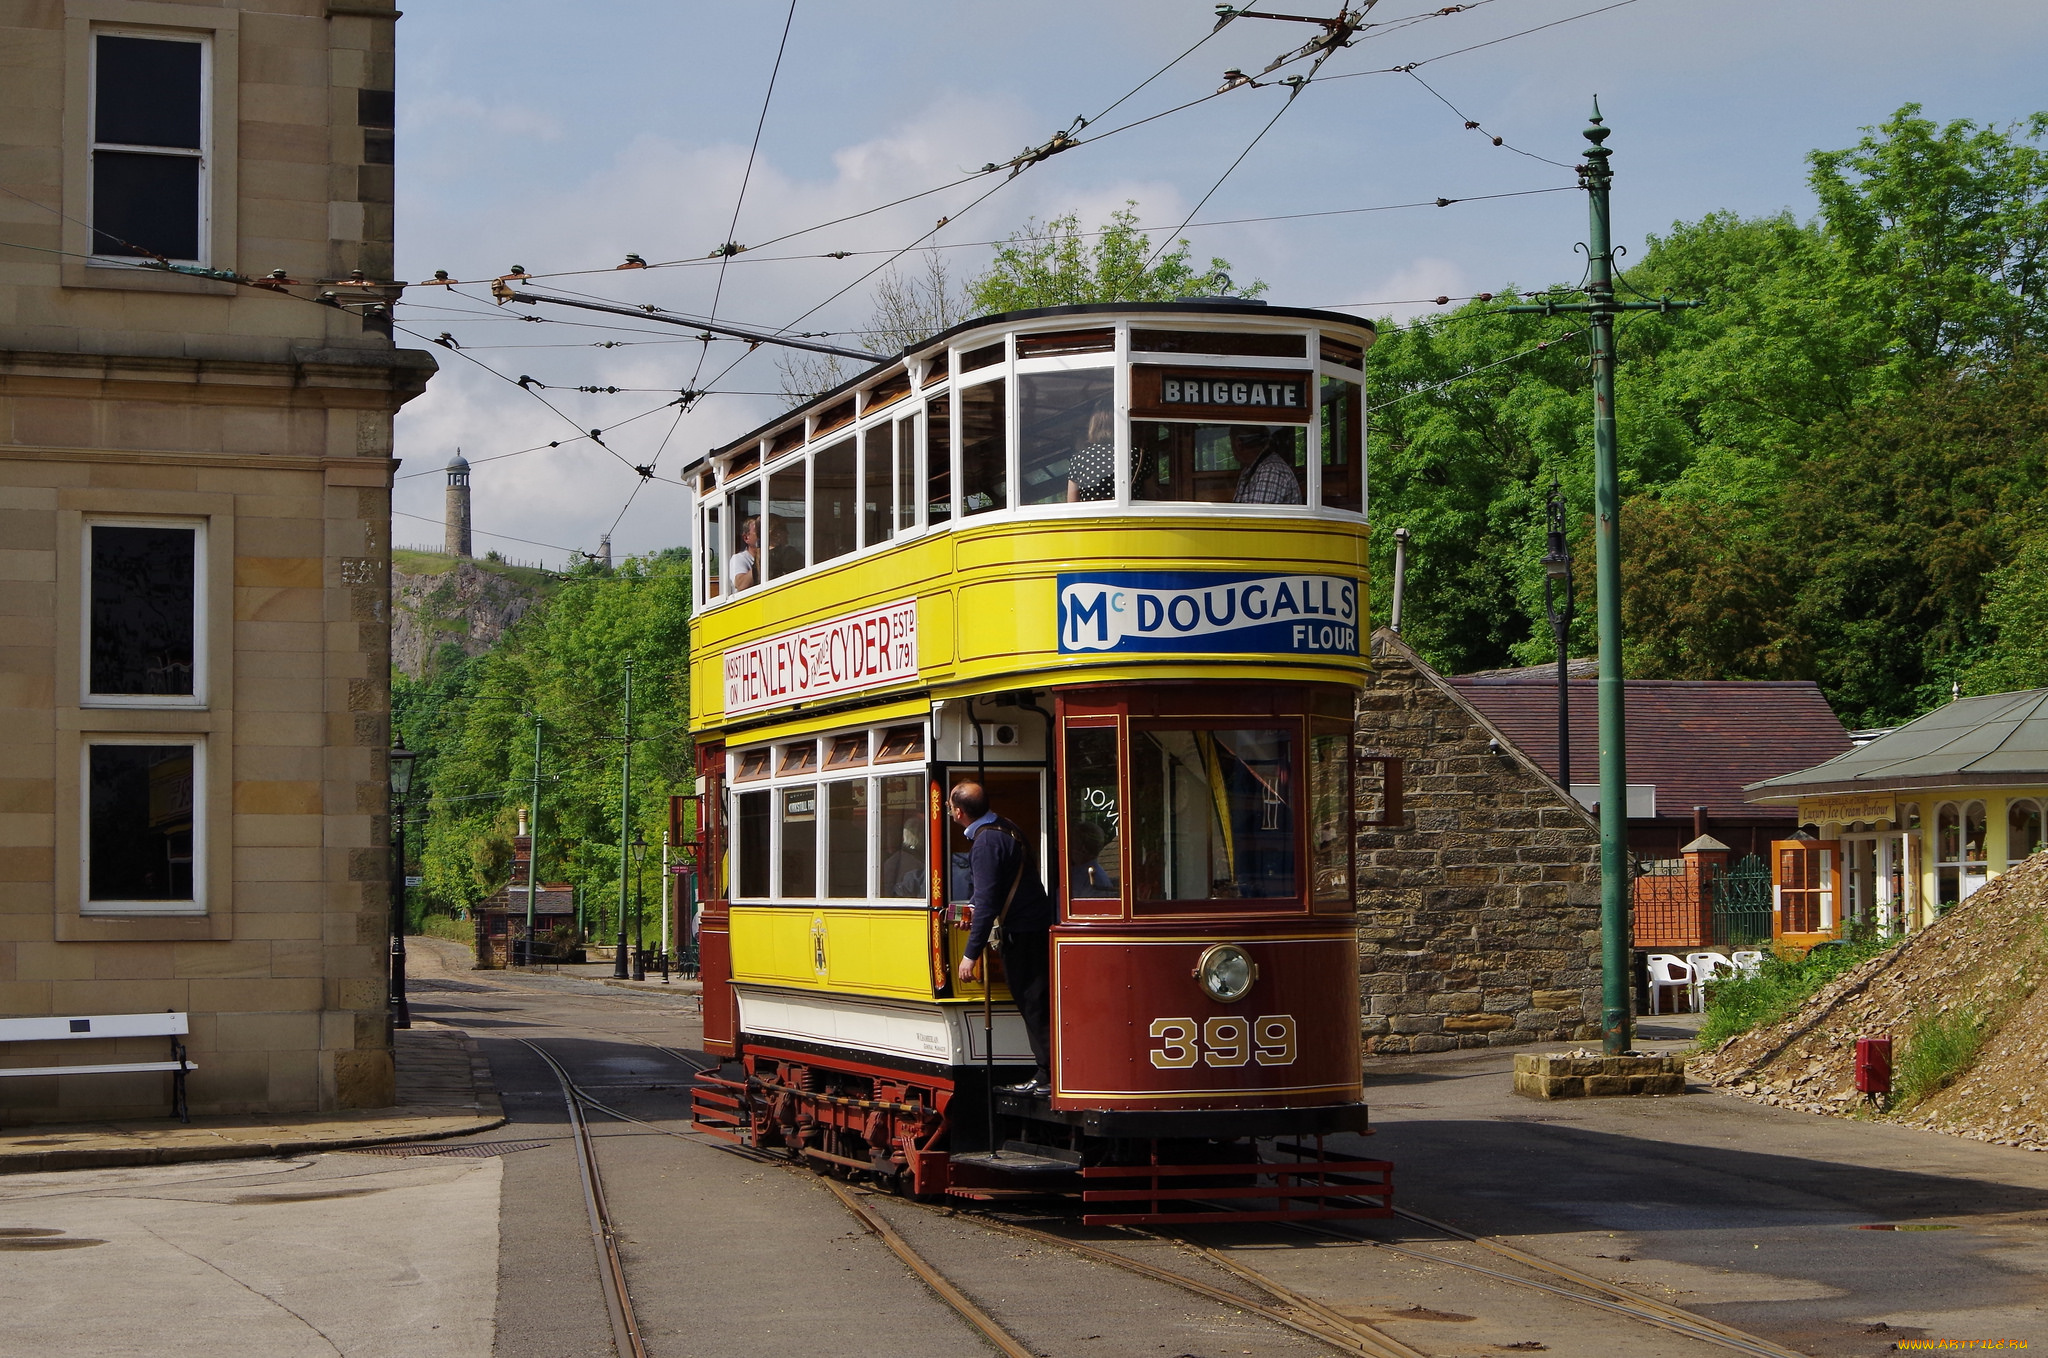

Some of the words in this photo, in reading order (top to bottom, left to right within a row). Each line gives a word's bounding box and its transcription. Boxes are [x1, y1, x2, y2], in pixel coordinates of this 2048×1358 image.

[1165, 380, 1297, 406] BRIGGATE
[811, 633, 829, 685] FAMOUS
[829, 616, 892, 683] CYDER
[1292, 625, 1355, 650] FLOUR
[726, 655, 741, 681] INSIST
[895, 641, 914, 670] 1791
[730, 684, 739, 706] ON
[1803, 807, 1825, 822] Luxury
[1828, 805, 1838, 818] Ice
[1840, 804, 1861, 819] Cream
[1863, 801, 1889, 817] Parlour
[1149, 1014, 1298, 1069] 399
